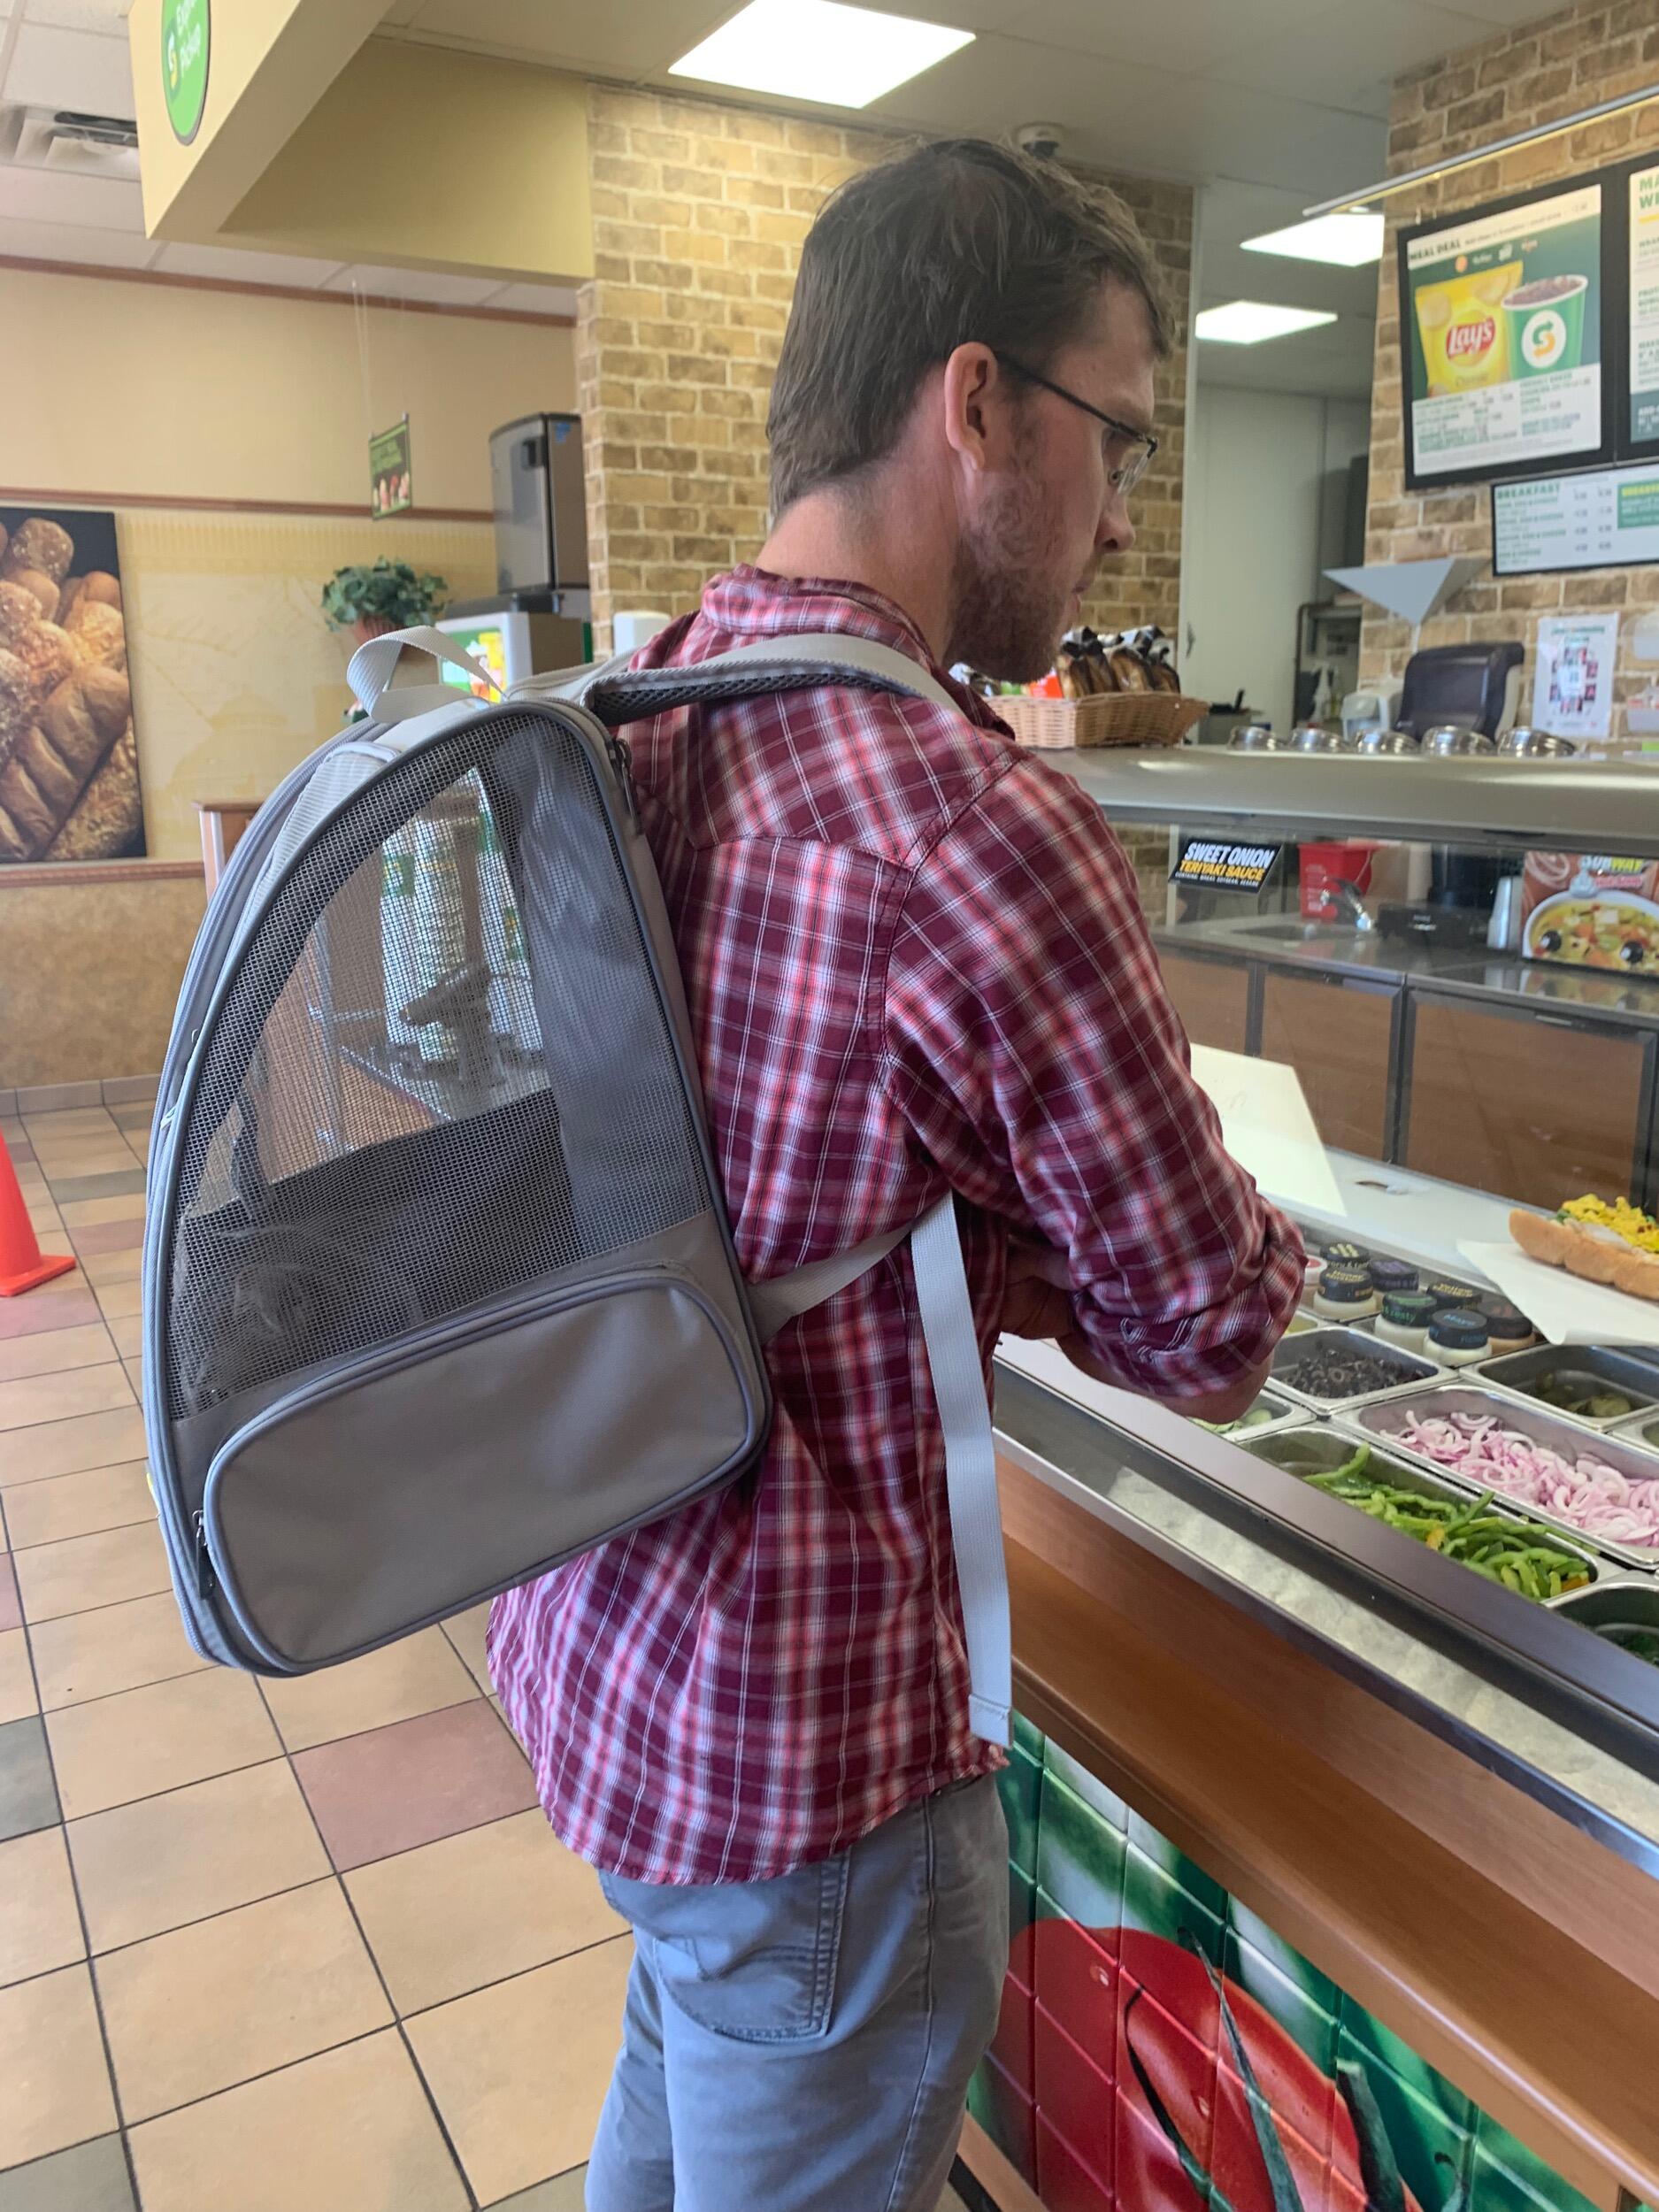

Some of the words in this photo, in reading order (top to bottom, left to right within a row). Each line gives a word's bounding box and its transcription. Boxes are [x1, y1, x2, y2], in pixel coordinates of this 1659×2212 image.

[1436, 238, 1461, 254] DEAL
[1497, 483, 1561, 499] BREAKFAST
[1184, 842, 1232, 864] SWEET
[1227, 847, 1275, 869] ONION
[1179, 859, 1227, 876] TERIYAKI
[1225, 865, 1265, 881] SAUCE
